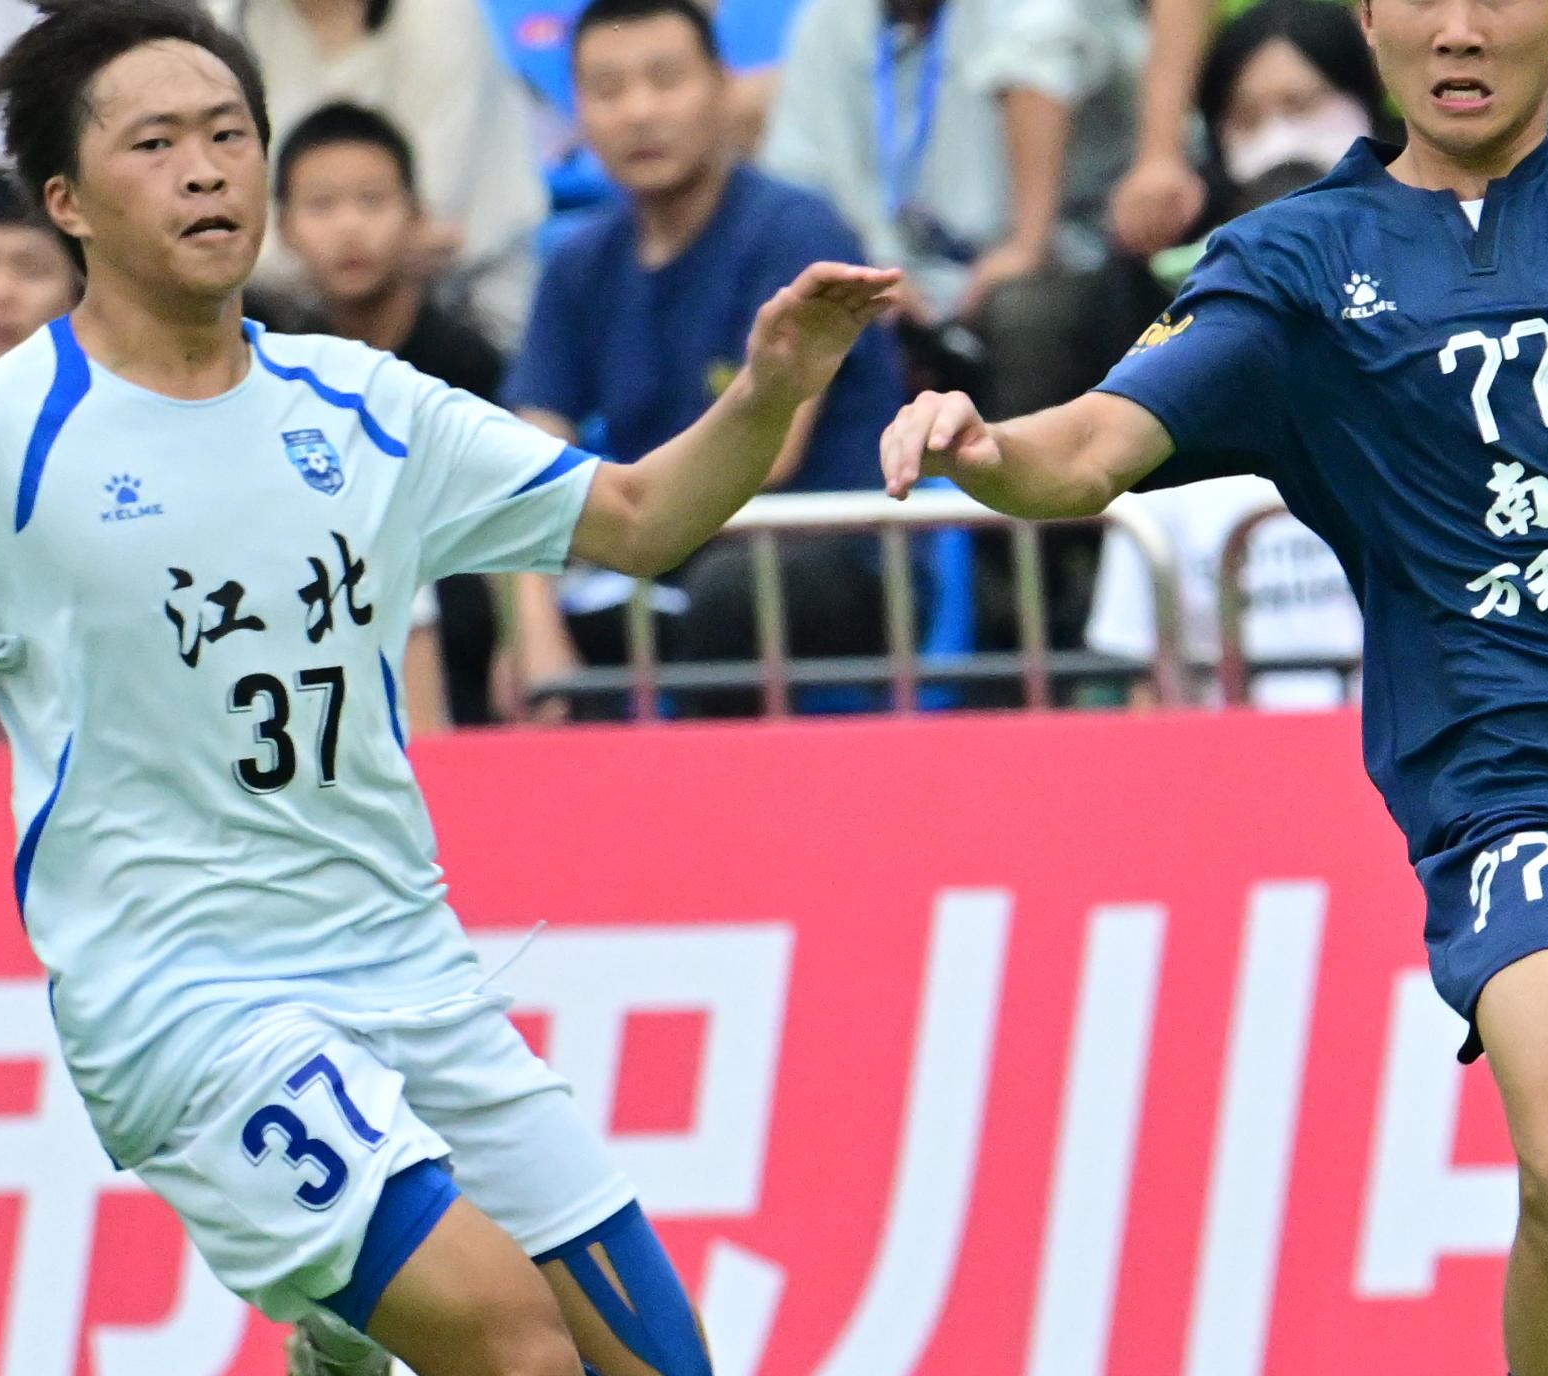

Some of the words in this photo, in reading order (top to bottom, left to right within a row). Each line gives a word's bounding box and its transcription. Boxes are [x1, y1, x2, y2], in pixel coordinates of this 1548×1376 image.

[1341, 300, 1397, 320] KELME
[100, 503, 164, 522] KELME
[165, 530, 373, 668] 江北
[226, 665, 345, 795] 37
[240, 1053, 389, 1212] 37
